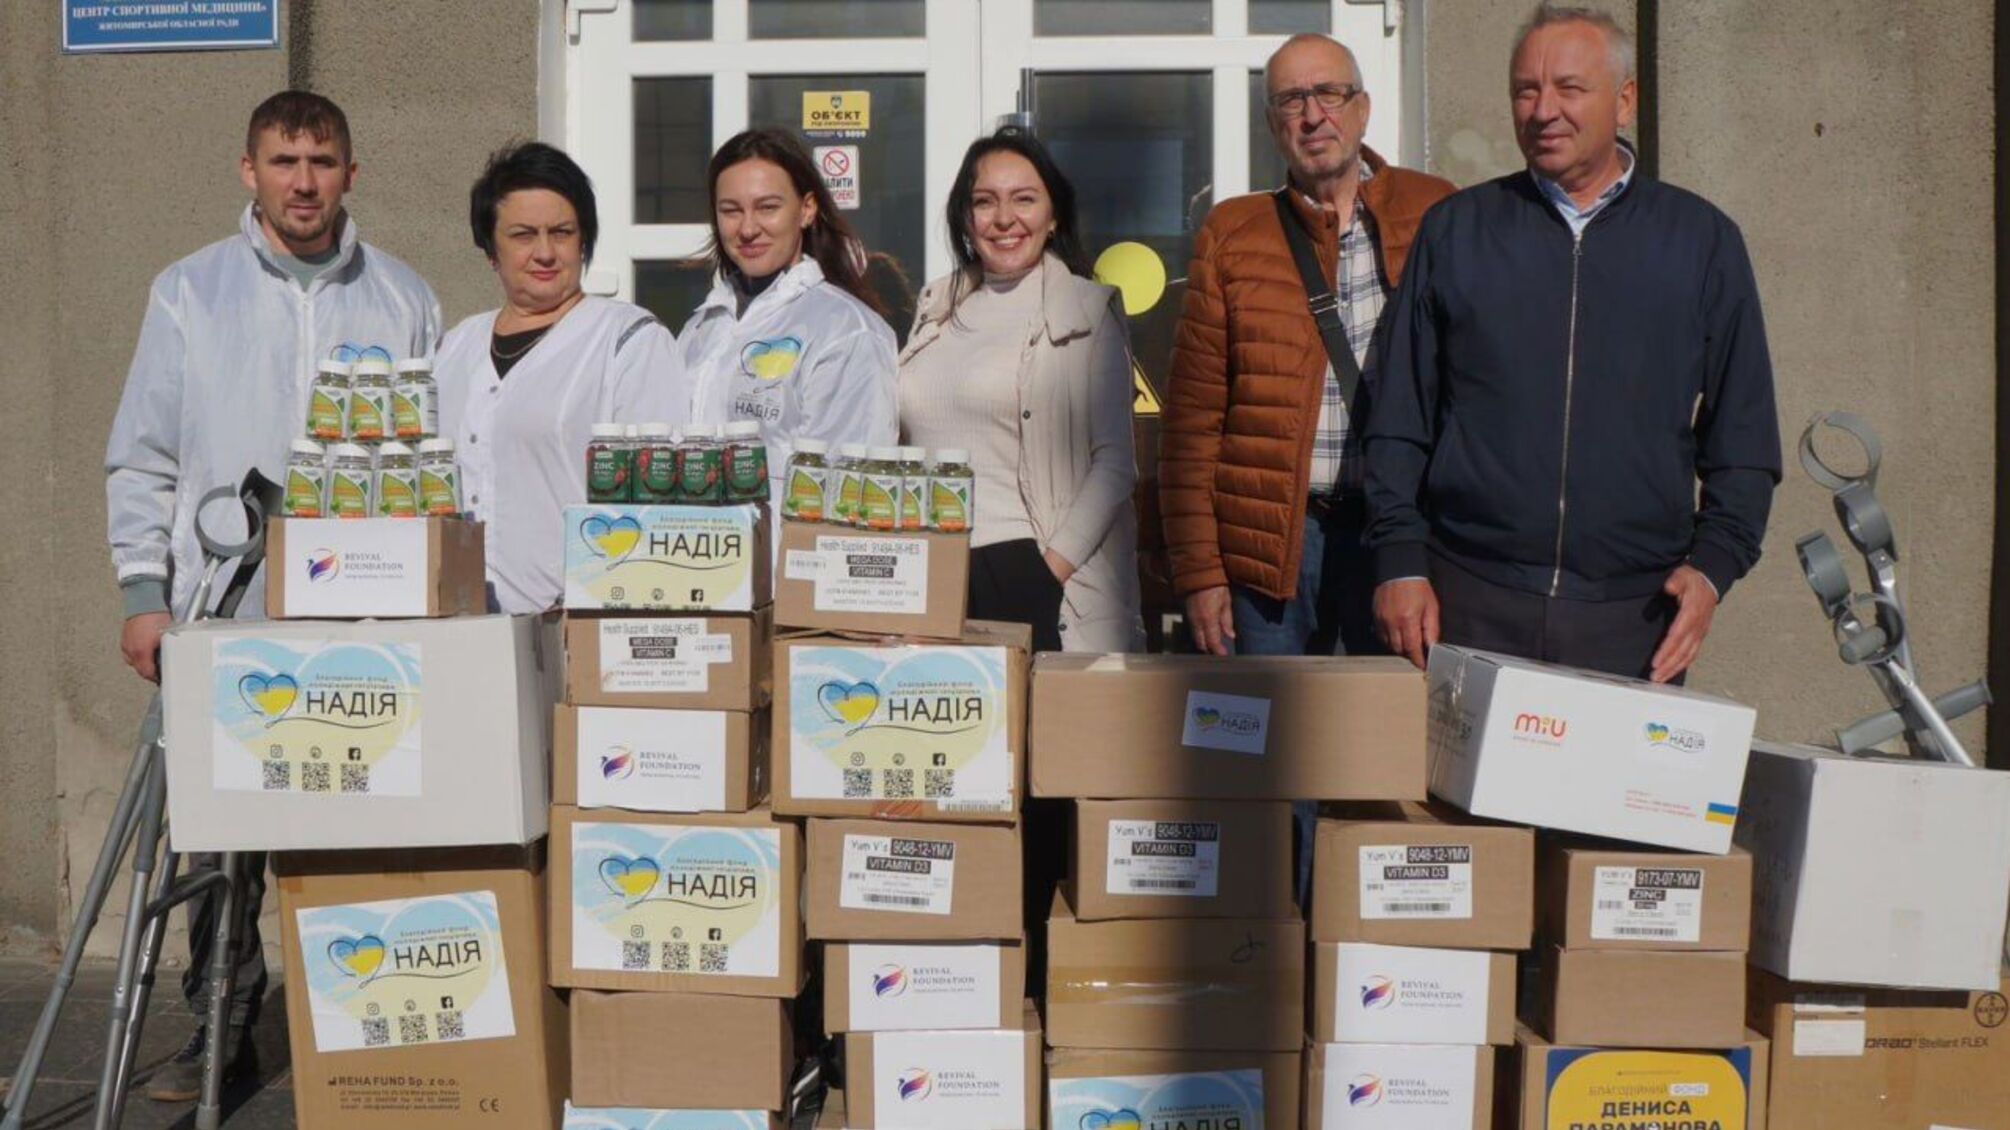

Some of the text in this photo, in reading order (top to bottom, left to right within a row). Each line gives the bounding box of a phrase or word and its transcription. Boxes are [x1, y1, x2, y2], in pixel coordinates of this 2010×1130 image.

[73, 6, 110, 18] ЦЕНТР
[735, 401, 780, 420] НАДІЯ
[650, 532, 741, 560] НАДІЯ
[306, 691, 397, 718] НАДІЯ
[889, 698, 982, 723] НАДІЯ
[640, 752, 677, 760] REVIVAL
[640, 762, 701, 771] FOUNDATION
[1134, 843, 1177, 855] VITAMIN
[870, 859, 912, 871] VITAMIN
[1387, 867, 1430, 878] VITAMIN
[668, 872, 756, 899] НАДІЯ
[1632, 890, 1663, 900] ZINC
[394, 940, 481, 969] НАДІЯ
[913, 976, 975, 984] FOUNDATION
[1401, 990, 1463, 999] FOUNDATION
[1960, 1036, 1987, 1048] FLEX
[339, 1077, 371, 1085] REHA
[373, 1077, 404, 1085] FUND
[938, 1081, 1000, 1089] FOUNDATION
[1388, 1089, 1450, 1097] FOUNDATION
[1601, 1100, 1691, 1118] ДЕНИСА
